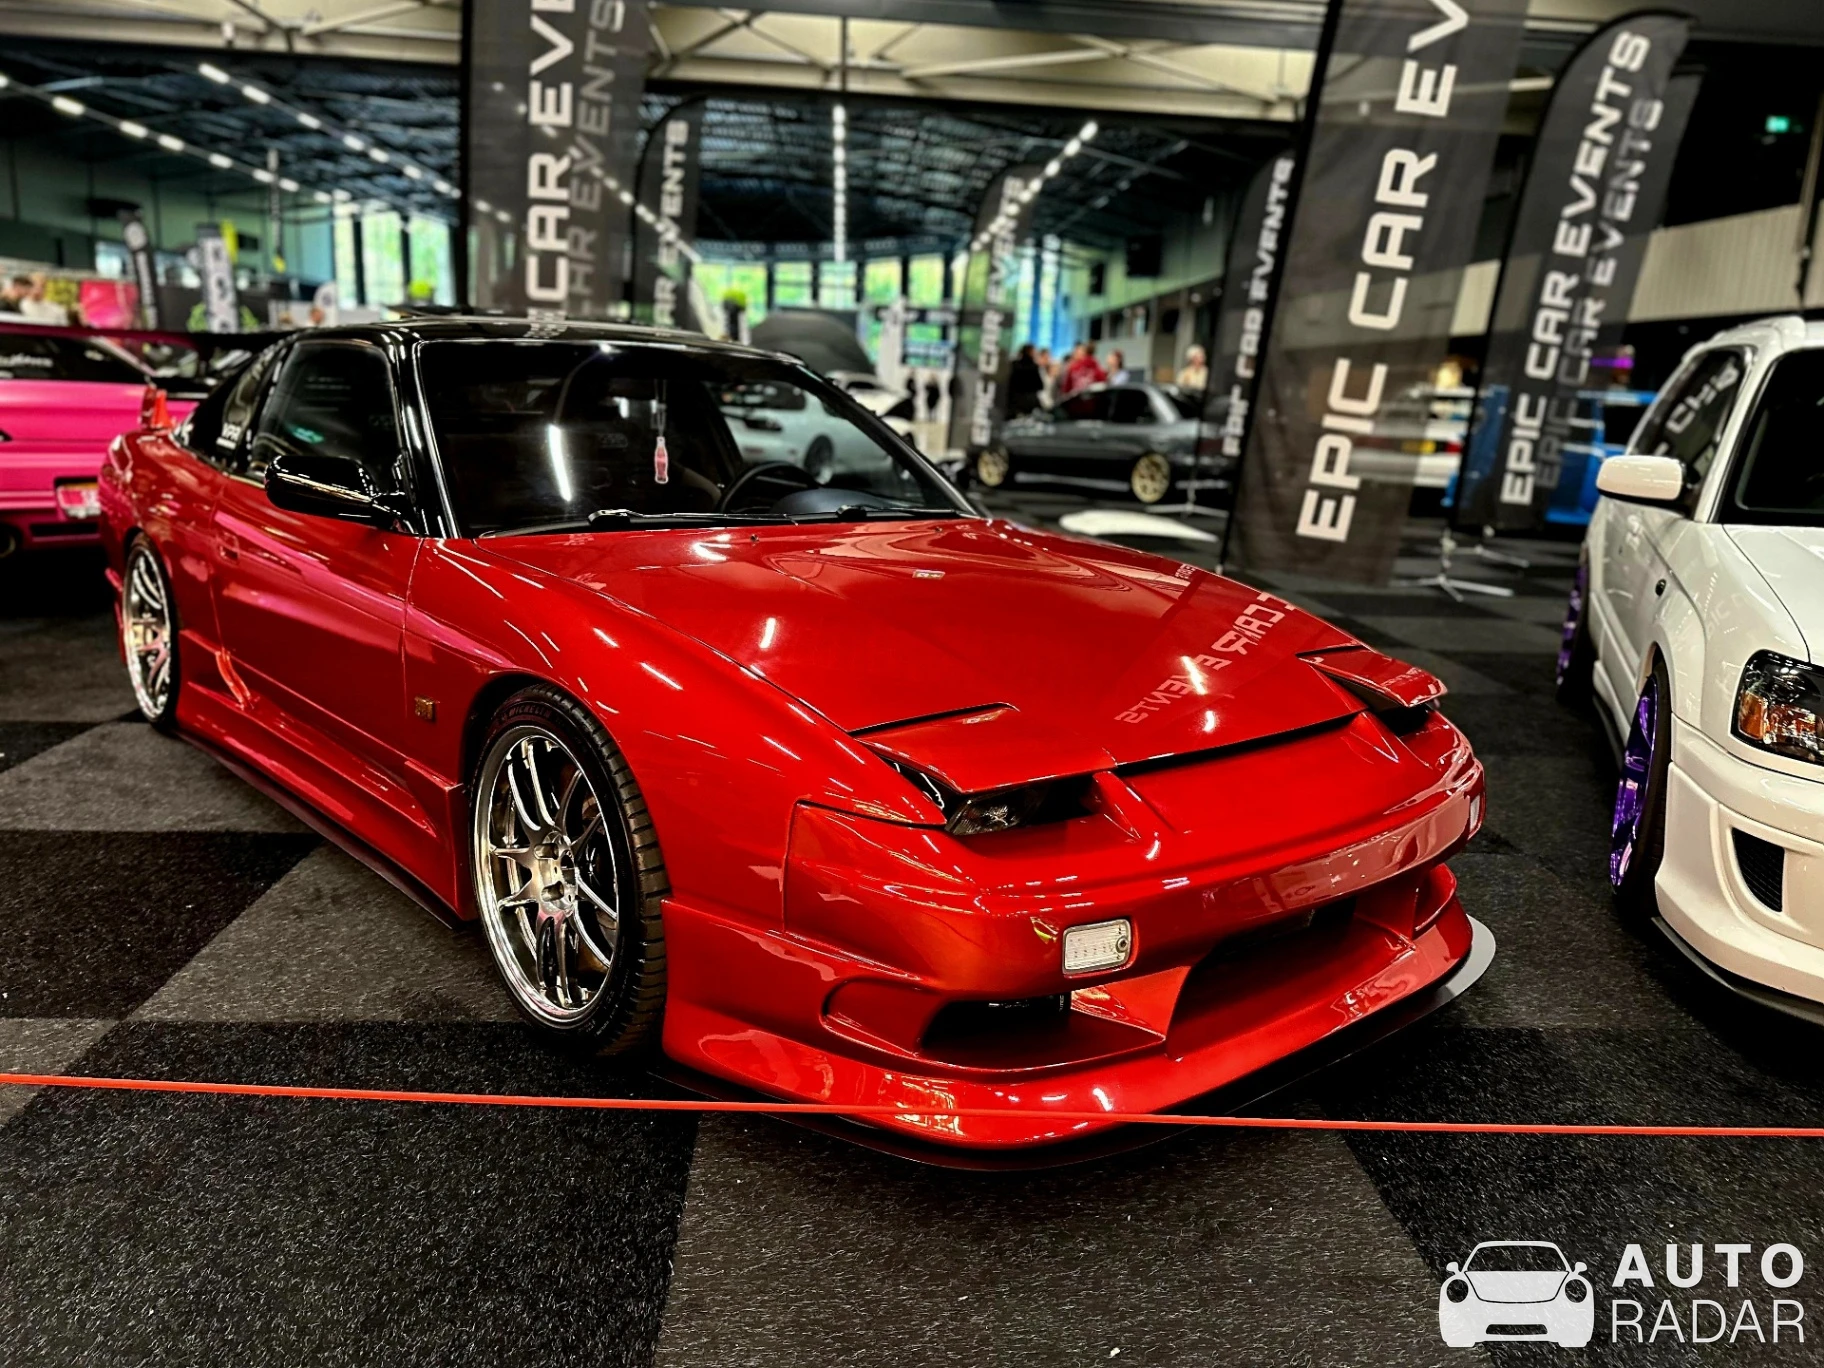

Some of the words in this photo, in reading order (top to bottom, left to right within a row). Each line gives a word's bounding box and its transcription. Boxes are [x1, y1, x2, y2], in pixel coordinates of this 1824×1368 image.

[529, 0, 575, 127] EV
[1552, 31, 1651, 257] EVENTS
[525, 153, 574, 302] CAR
[1249, 157, 1296, 301] EVENTS
[1296, 358, 1388, 542] EPIC
[1348, 147, 1438, 331] CAR
[1525, 270, 1580, 381] CAR
[1500, 392, 1547, 506] EPIC
